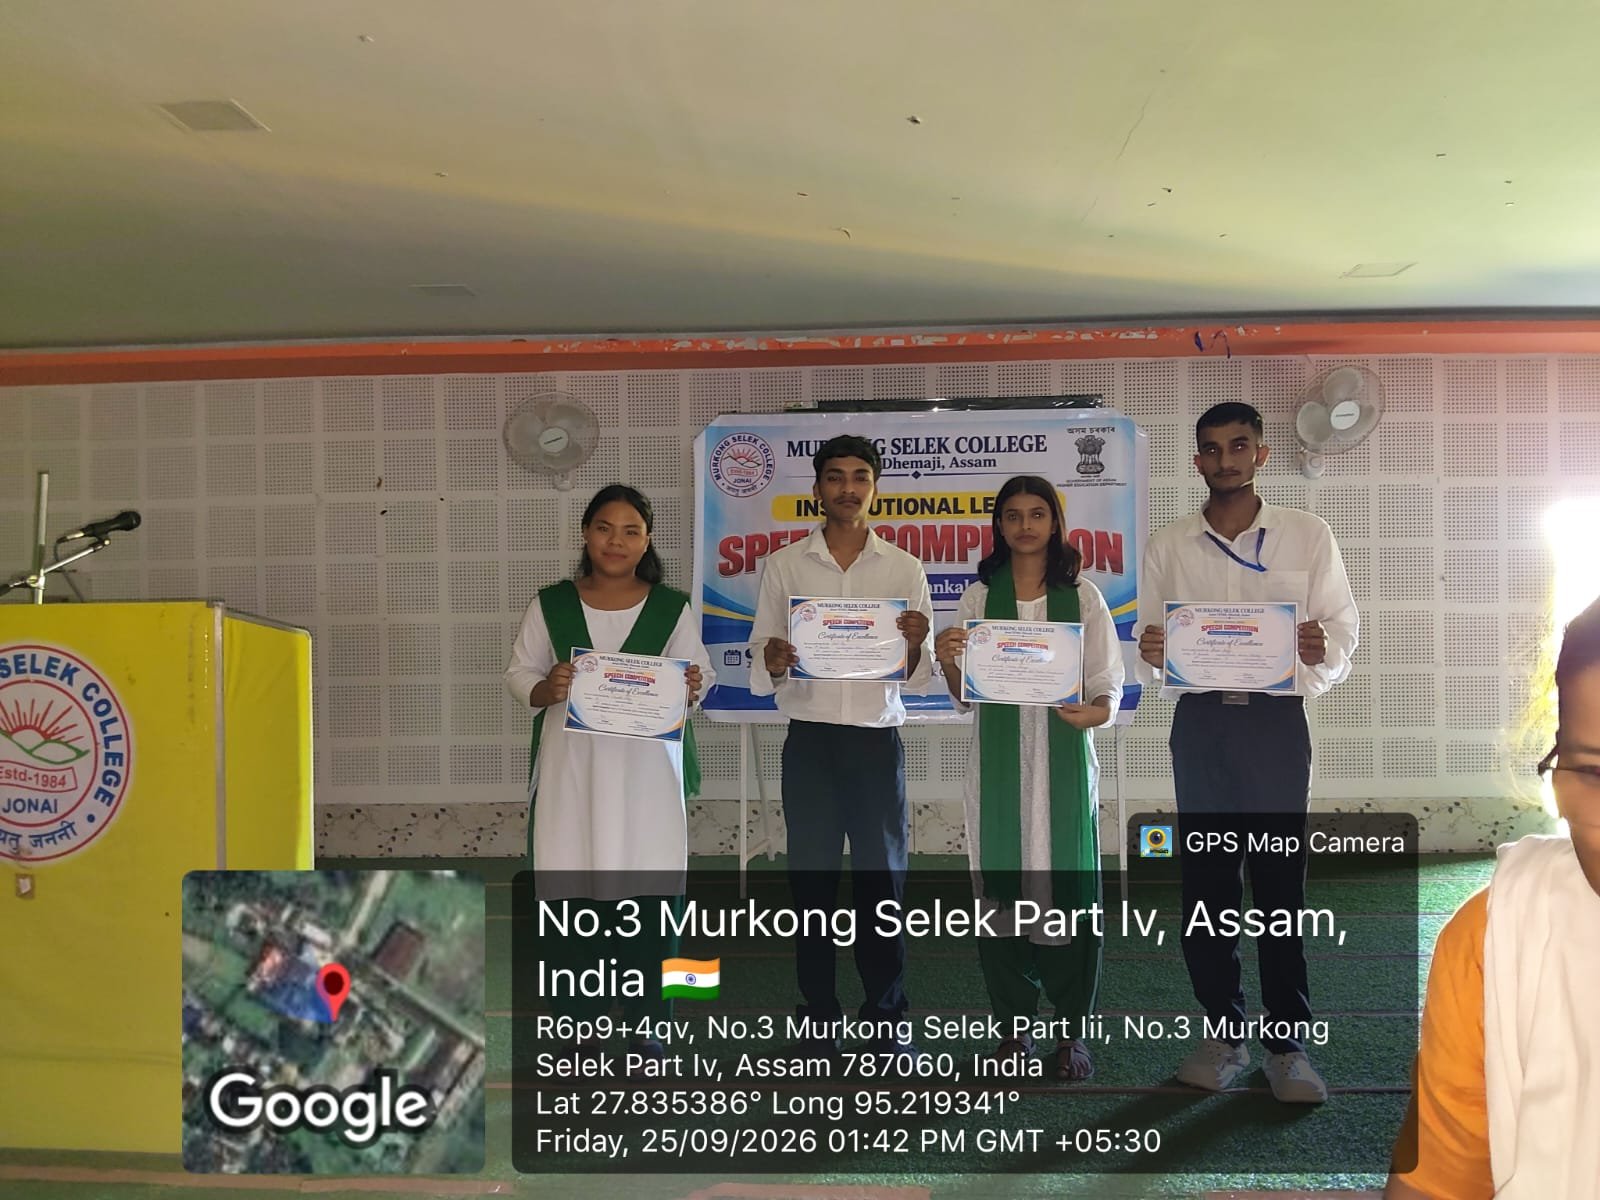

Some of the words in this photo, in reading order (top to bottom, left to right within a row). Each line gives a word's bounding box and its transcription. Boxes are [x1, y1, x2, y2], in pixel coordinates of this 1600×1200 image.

[890, 437, 951, 456] SELEK
[954, 434, 1048, 454] COLLEGE
[712, 440, 731, 481] MURKONG
[732, 434, 759, 446] SELEK
[759, 443, 773, 481] COLLEGE
[882, 456, 945, 471] Dhemaji,
[949, 456, 997, 469] Assam
[1200, 624, 1222, 632] SPEECH
[996, 641, 1016, 649] SPEECH
[0, 653, 80, 687] SELEK
[82, 682, 124, 808] COLLEGE
[2, 798, 58, 814] JONAI
[28, 820, 78, 849] जननी
